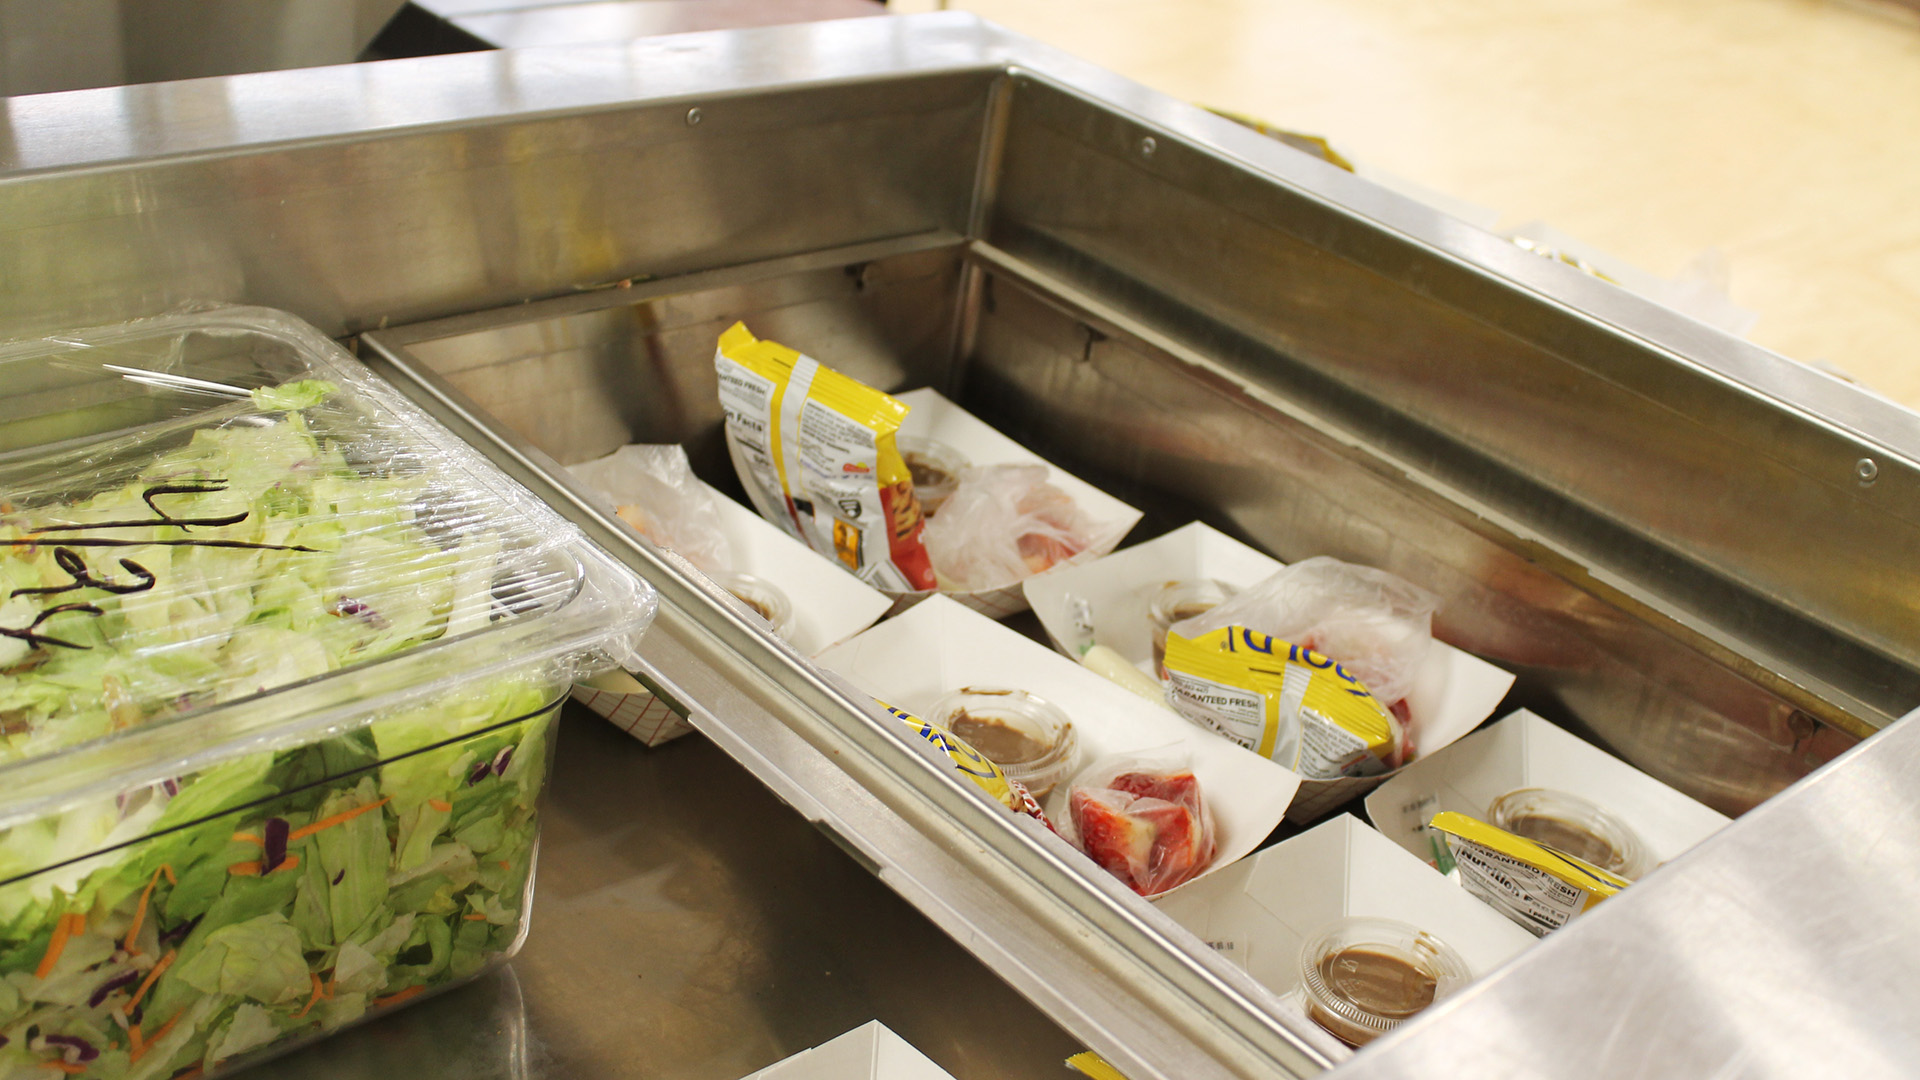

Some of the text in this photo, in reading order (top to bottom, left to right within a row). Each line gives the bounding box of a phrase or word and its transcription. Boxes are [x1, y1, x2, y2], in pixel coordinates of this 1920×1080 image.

[1229, 697, 1258, 709] FRESH
[1461, 849, 1520, 897] Nutrition
[1541, 871, 1577, 897] FRESH
